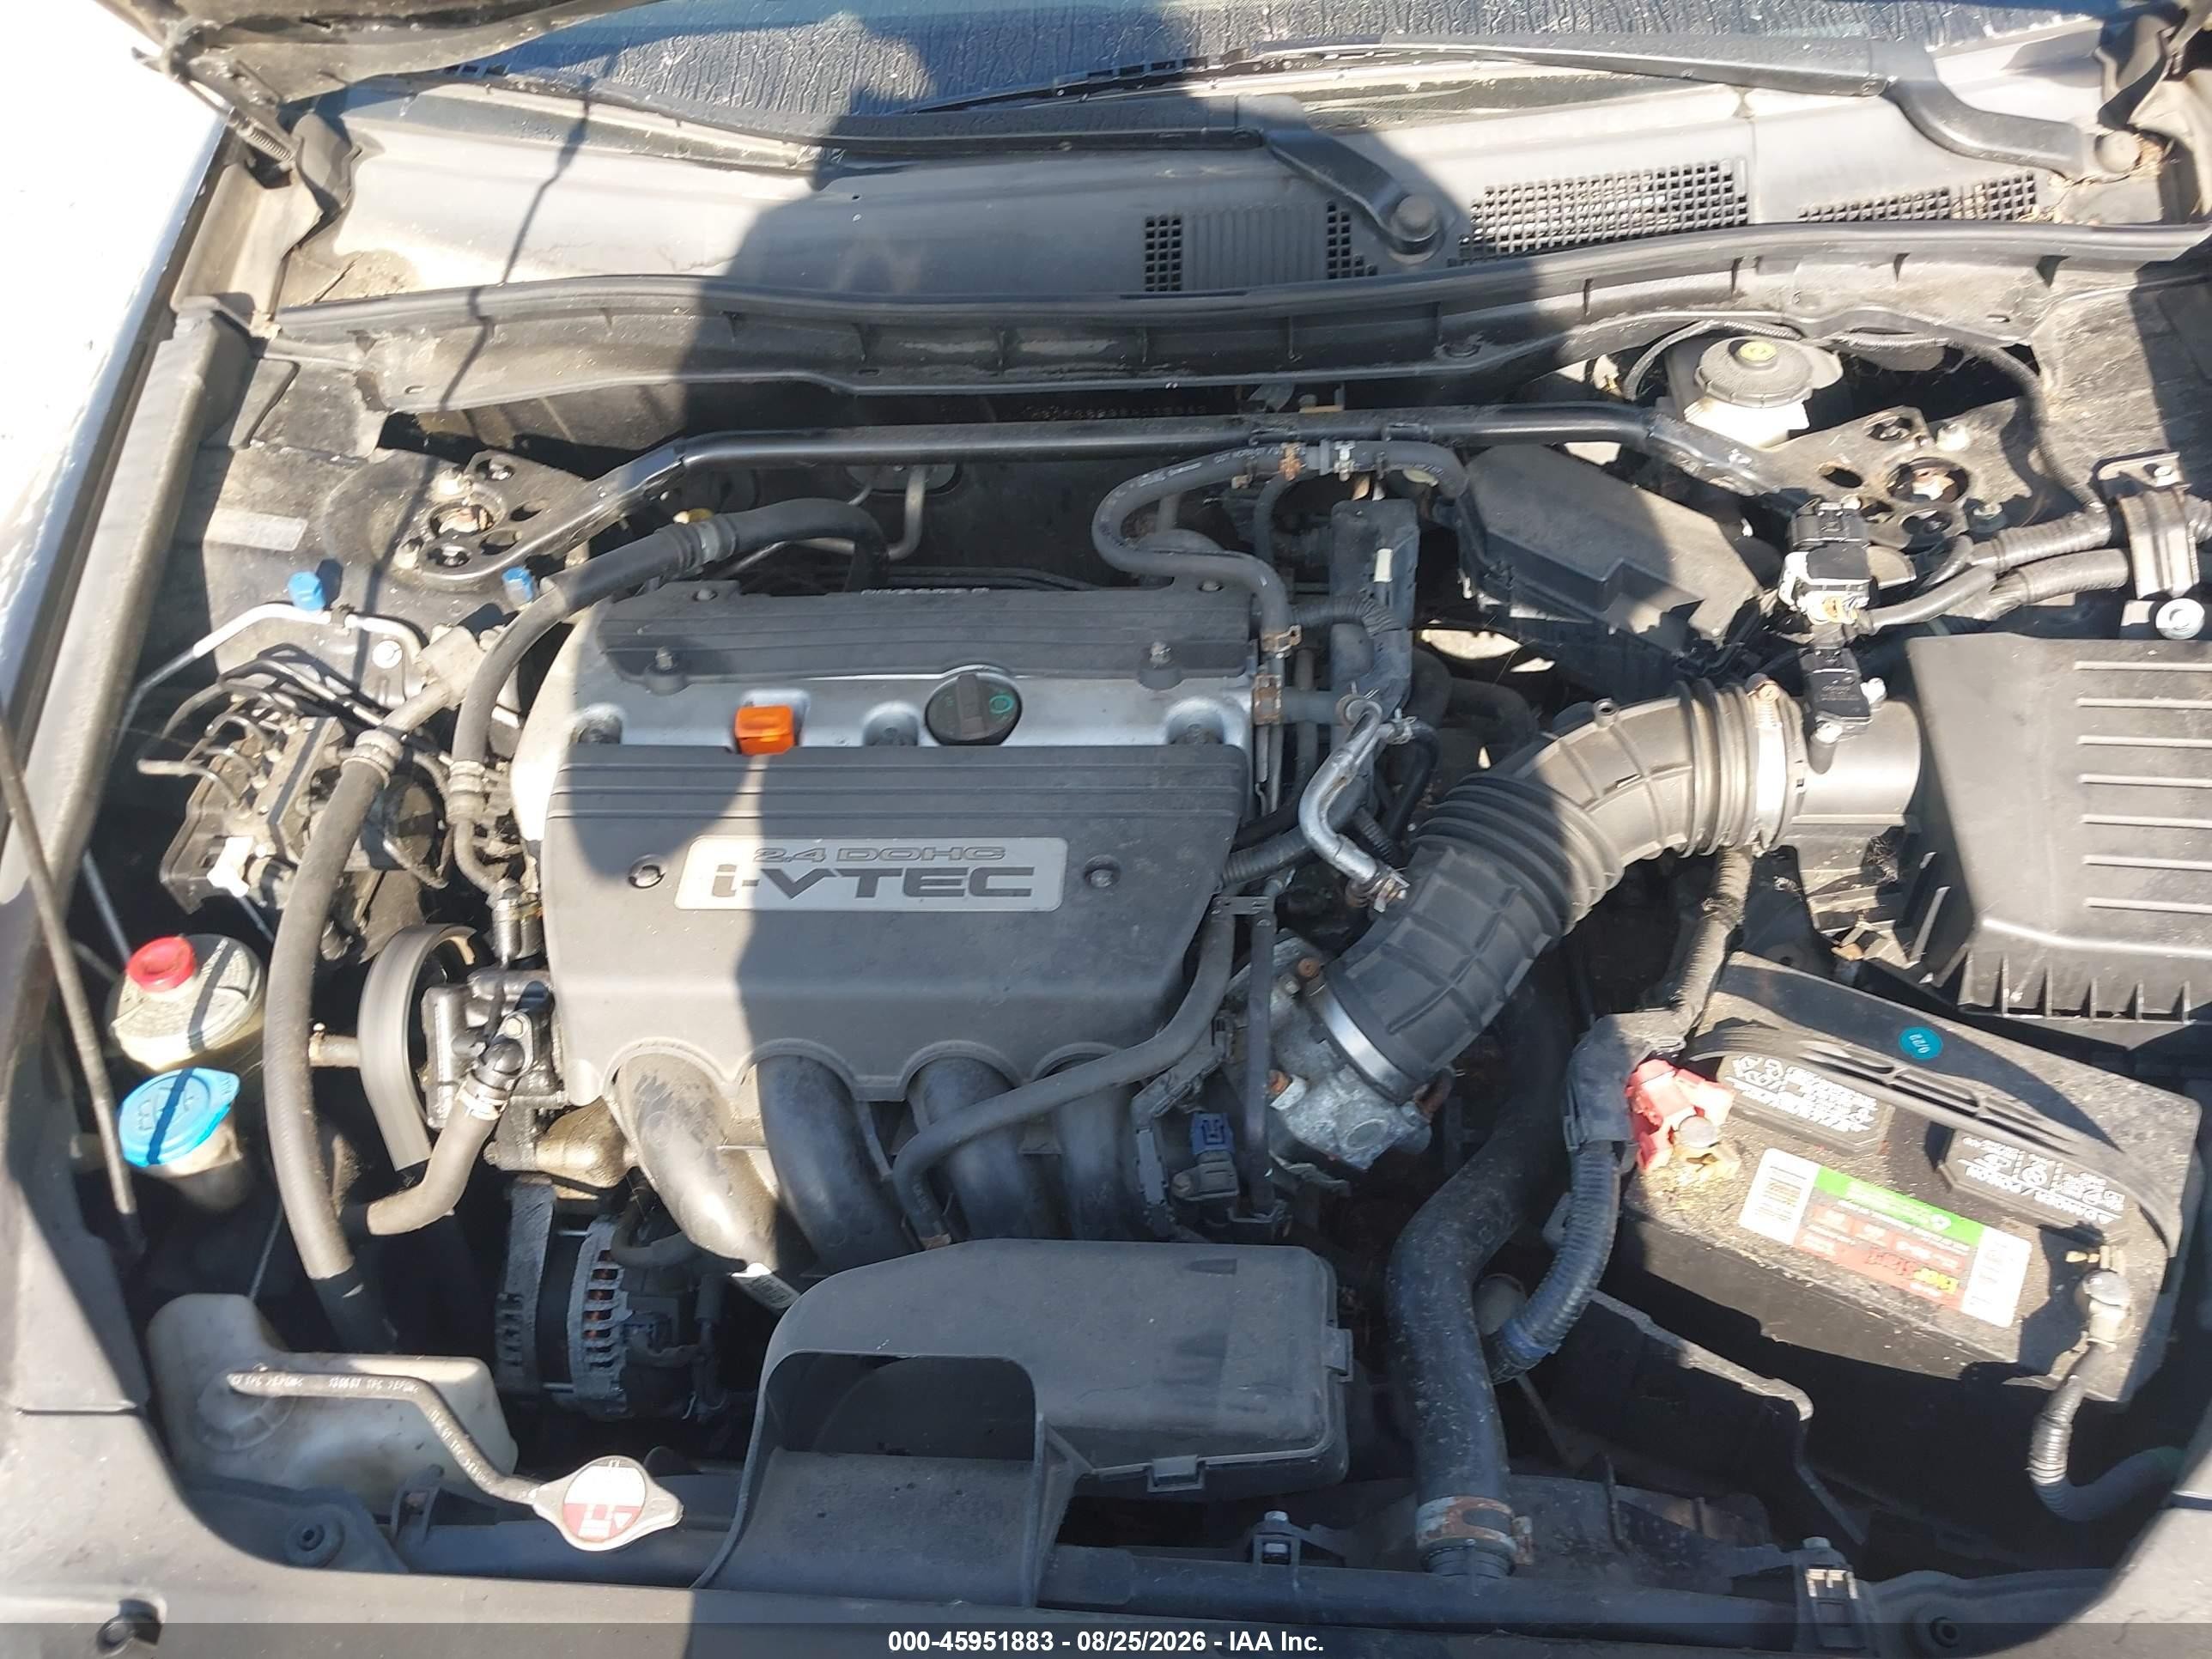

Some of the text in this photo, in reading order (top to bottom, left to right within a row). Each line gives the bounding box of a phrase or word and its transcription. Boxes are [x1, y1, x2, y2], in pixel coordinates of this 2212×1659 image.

[755, 846, 1006, 862] 2.4 DOHC
[711, 864, 1036, 899] i-VTEC
